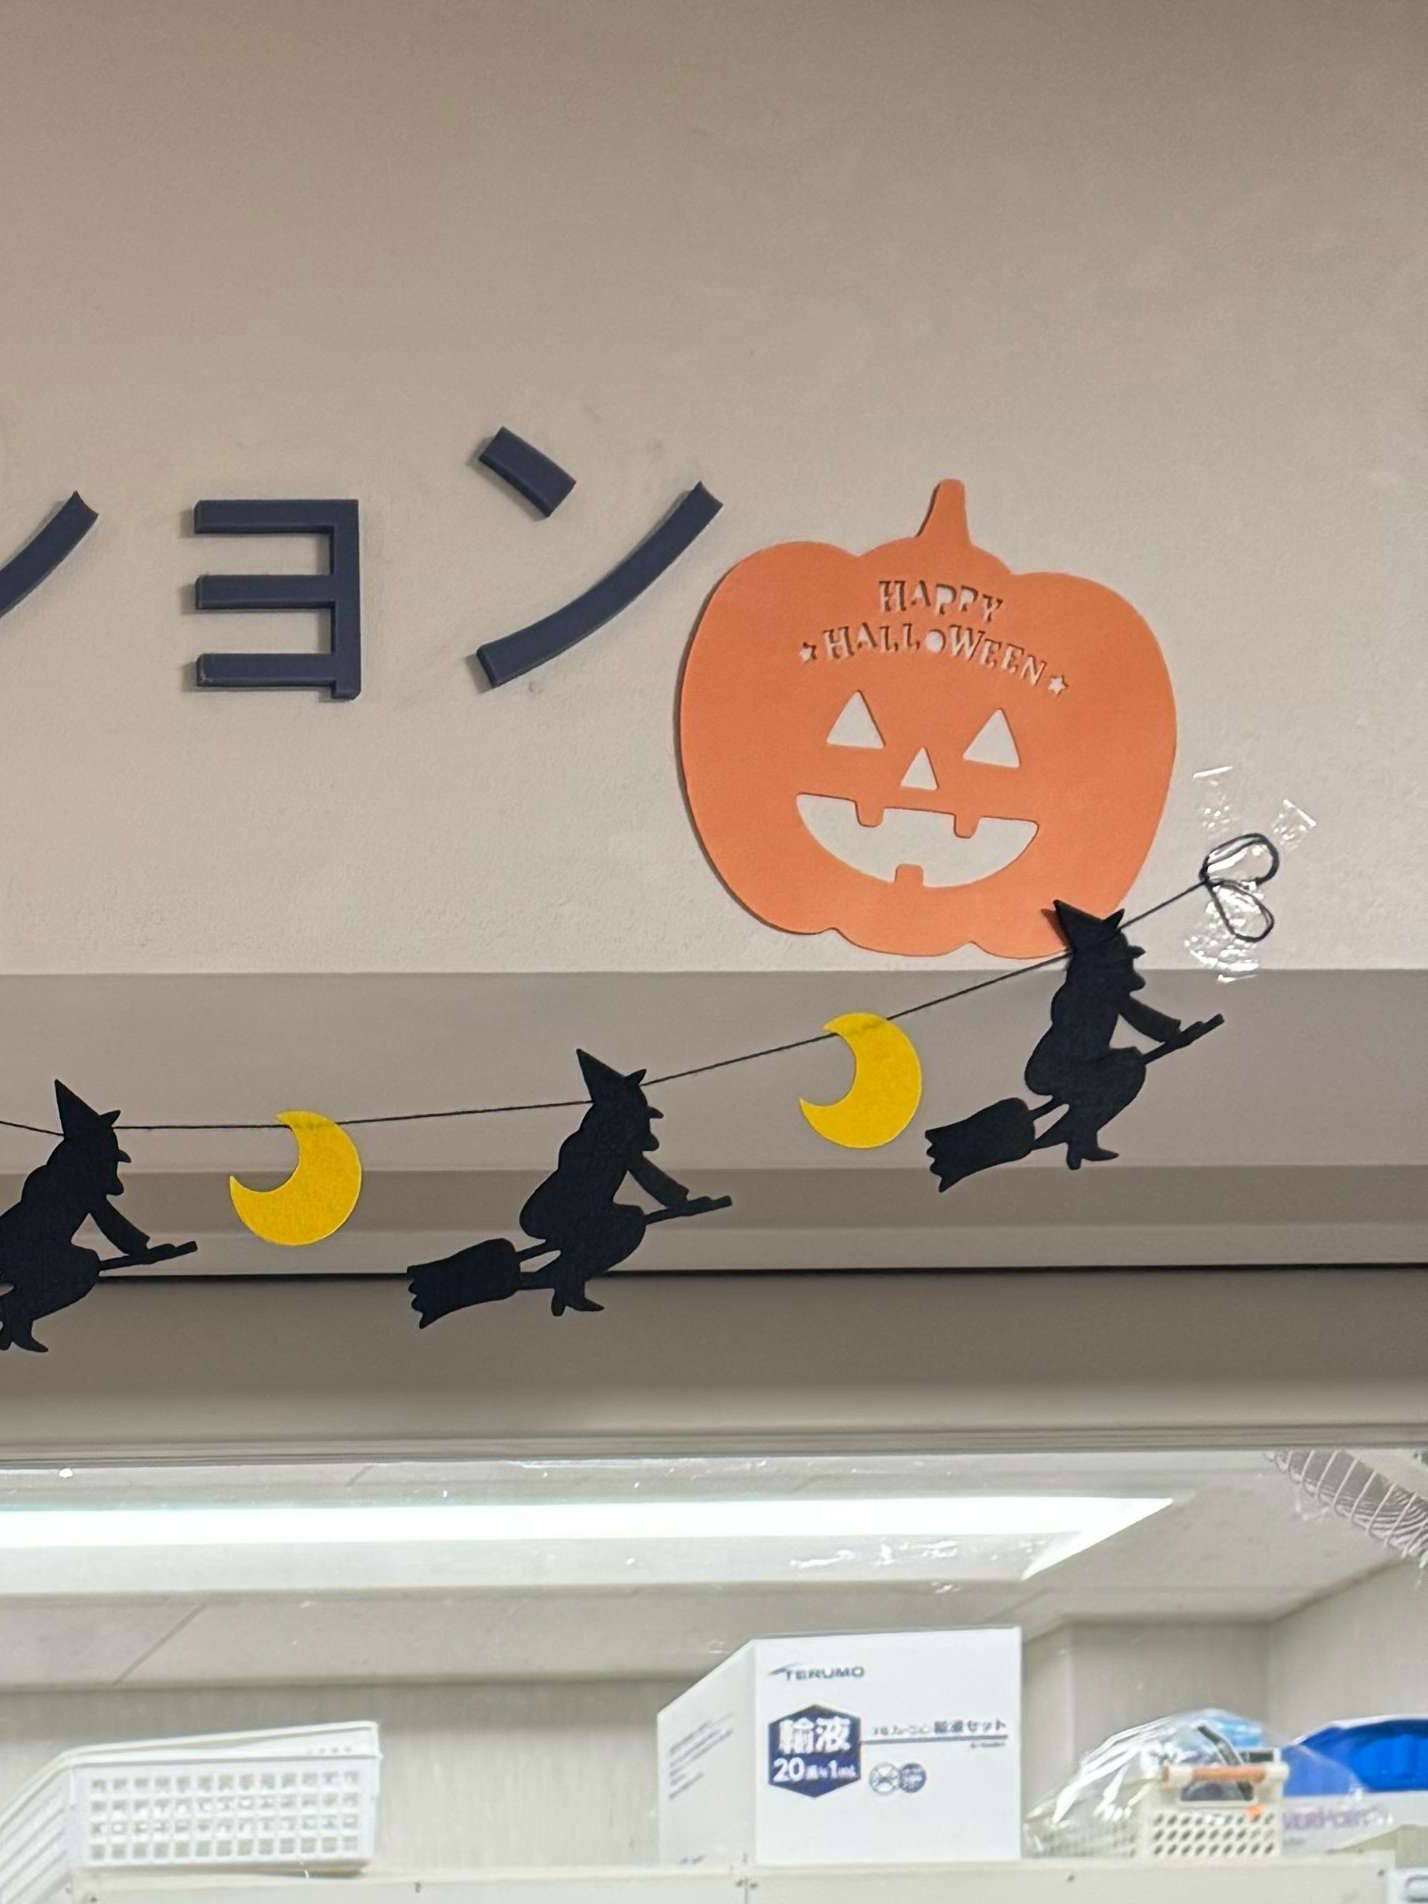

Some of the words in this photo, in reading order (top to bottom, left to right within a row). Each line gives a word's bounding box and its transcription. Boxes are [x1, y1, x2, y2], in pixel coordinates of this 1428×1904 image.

[879, 580, 1003, 624] HAPPY
[823, 622, 1048, 688] HALLOWEEN
[784, 1665, 865, 1682] TERUMO
[778, 1715, 851, 1755] 輸液
